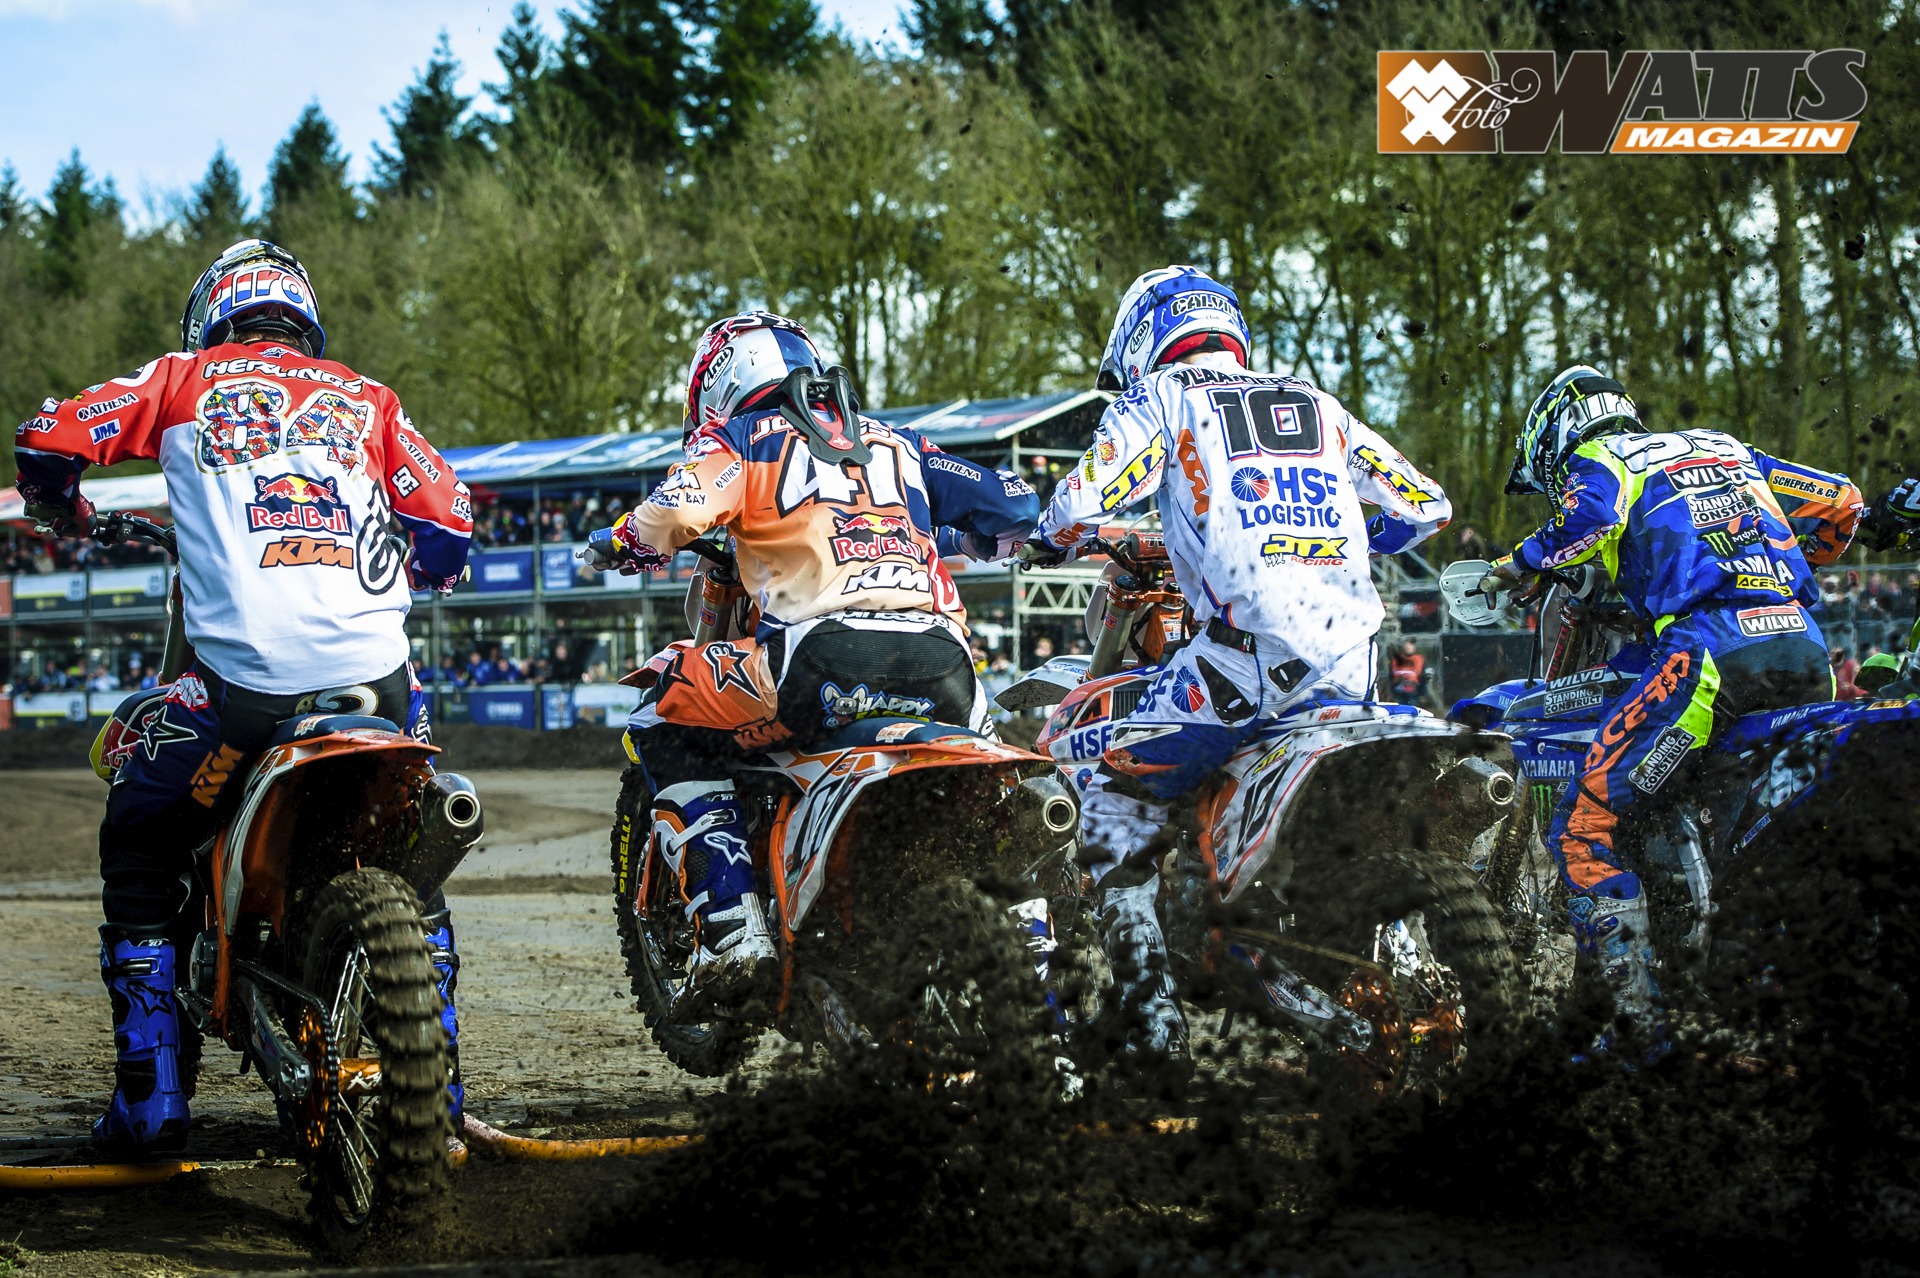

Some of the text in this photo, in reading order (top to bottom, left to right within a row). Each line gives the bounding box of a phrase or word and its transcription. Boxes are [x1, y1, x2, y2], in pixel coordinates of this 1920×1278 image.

[202, 358, 364, 395] HERLINGS
[705, 349, 731, 384] Arai
[89, 393, 137, 418] ATHENA
[199, 380, 371, 474] 84
[1205, 387, 1325, 461] 10
[406, 443, 440, 483] ATHENA
[939, 460, 980, 481] ATHENA
[1100, 429, 1168, 513] JTX
[1672, 464, 1747, 486] WILVO
[1273, 466, 1338, 506] HSF
[1353, 445, 1439, 515] JTX
[1772, 474, 1840, 500] SCHEPERS & CO
[685, 492, 706, 505] BAY
[252, 505, 348, 531] Red Bull
[260, 536, 355, 569] KTM
[835, 535, 921, 564] Red Bull
[1260, 534, 1348, 560] JTX
[1291, 555, 1343, 566] RACING
[841, 561, 931, 595] KTM
[1742, 614, 1804, 632] WILVO
[1550, 669, 1605, 690] WILVO
[857, 695, 931, 716] HAPPY
[1318, 707, 1343, 722] KTM
[1545, 696, 1602, 714] CONSTRUCT
[1770, 707, 1810, 729] YAMAHA
[733, 720, 793, 749] KTM
[1070, 723, 1114, 762] HSF
[1251, 739, 1294, 776] JTX
[1522, 759, 1576, 777] YAMAHA
[1645, 732, 1693, 790] CONSTRUCT
[190, 743, 244, 809] KTM
[619, 814, 631, 893] PIRELLI
